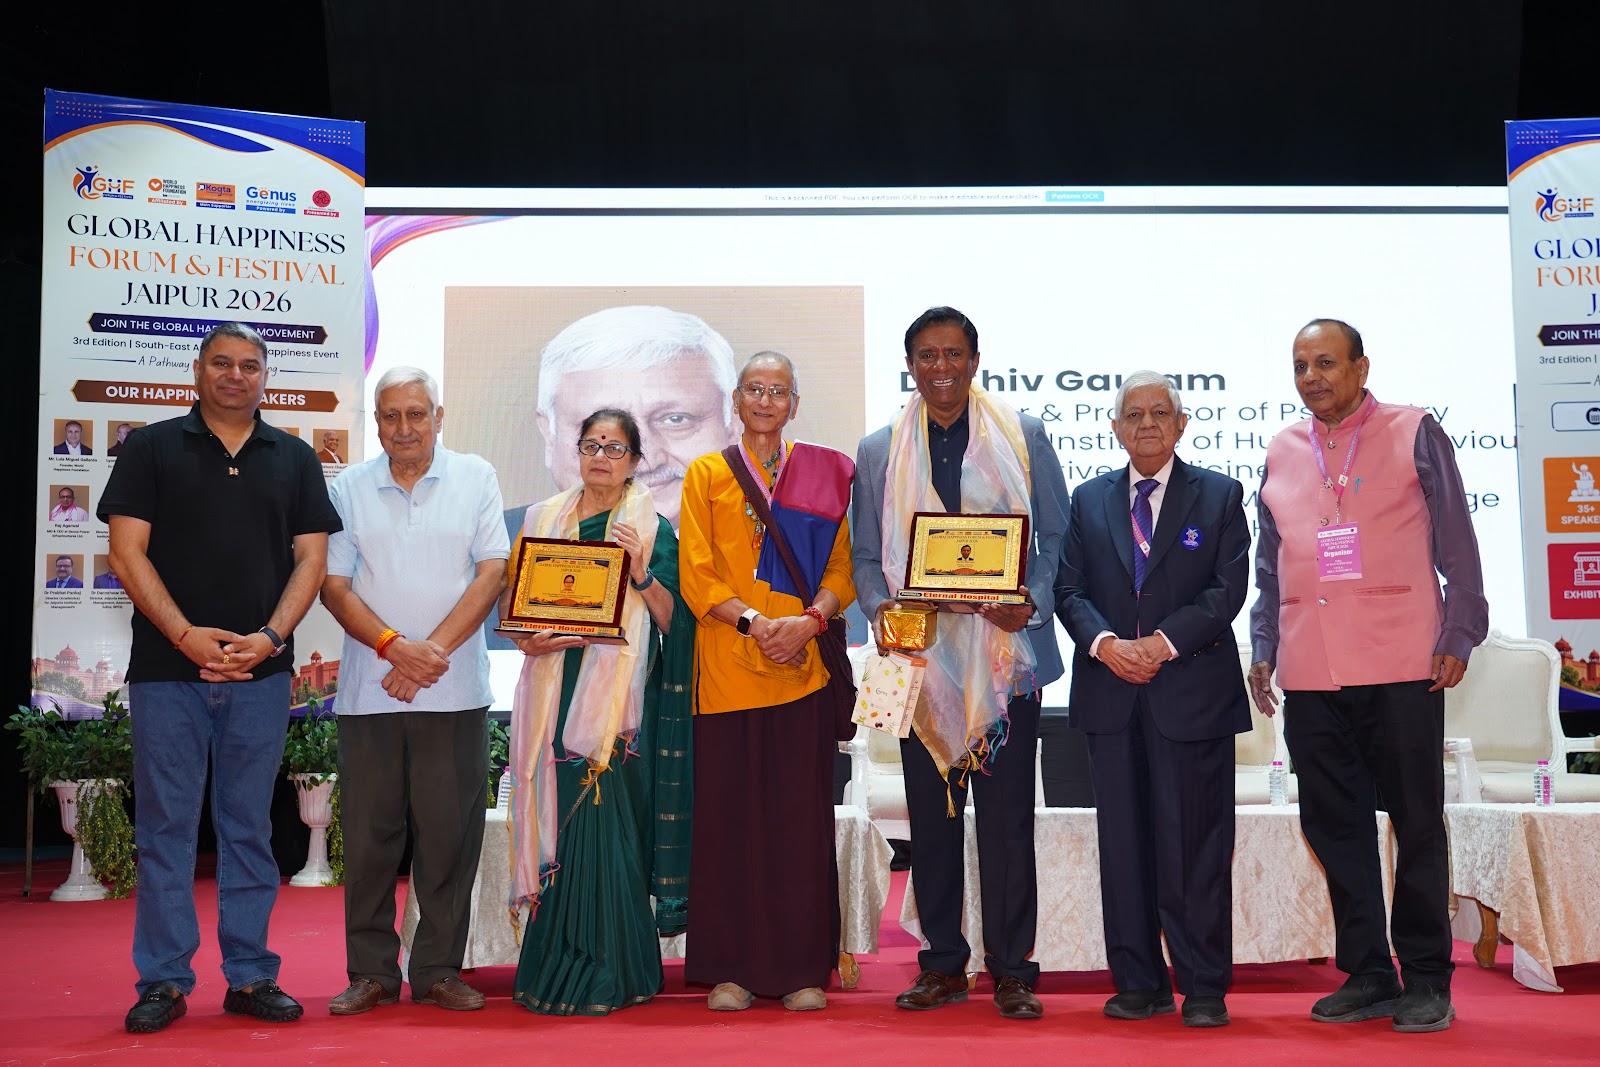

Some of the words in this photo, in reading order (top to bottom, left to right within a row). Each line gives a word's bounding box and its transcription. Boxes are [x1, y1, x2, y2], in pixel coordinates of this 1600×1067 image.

[206, 184, 230, 196] Kogta
[246, 186, 297, 202] Genus
[67, 213, 189, 244] GLOBAL
[196, 224, 346, 254] HAPPINESS
[1534, 238, 1600, 260] GLO
[70, 245, 177, 274] FORUM
[184, 254, 211, 276] &
[218, 256, 345, 286] FESTIVAL
[1537, 266, 1600, 287] FOR
[121, 282, 220, 308] JAIPUR
[226, 288, 292, 312] 2026
[100, 318, 128, 329] JOIN
[130, 320, 150, 330] THE
[152, 322, 194, 333] GLOBAL
[256, 328, 316, 340] MOVEMENT
[1551, 330, 1580, 340] JOIN
[72, 336, 90, 346] 3rd
[92, 338, 127, 348] Edition
[135, 340, 190, 351] South-East
[268, 348, 311, 358] appiness
[314, 350, 340, 358] Event
[138, 356, 145, 366] A
[149, 356, 190, 372] Pathway
[1540, 356, 1556, 364] 3rd
[1558, 354, 1592, 364] Edition
[982, 368, 1044, 392] hiv
[105, 386, 140, 399] OUR
[142, 387, 200, 401] HAPPIN
[259, 393, 306, 406] AKERS
[1041, 404, 1062, 422] &
[1238, 402, 1268, 421] of
[1192, 431, 1222, 450] of
[1577, 504, 1595, 514] 35+
